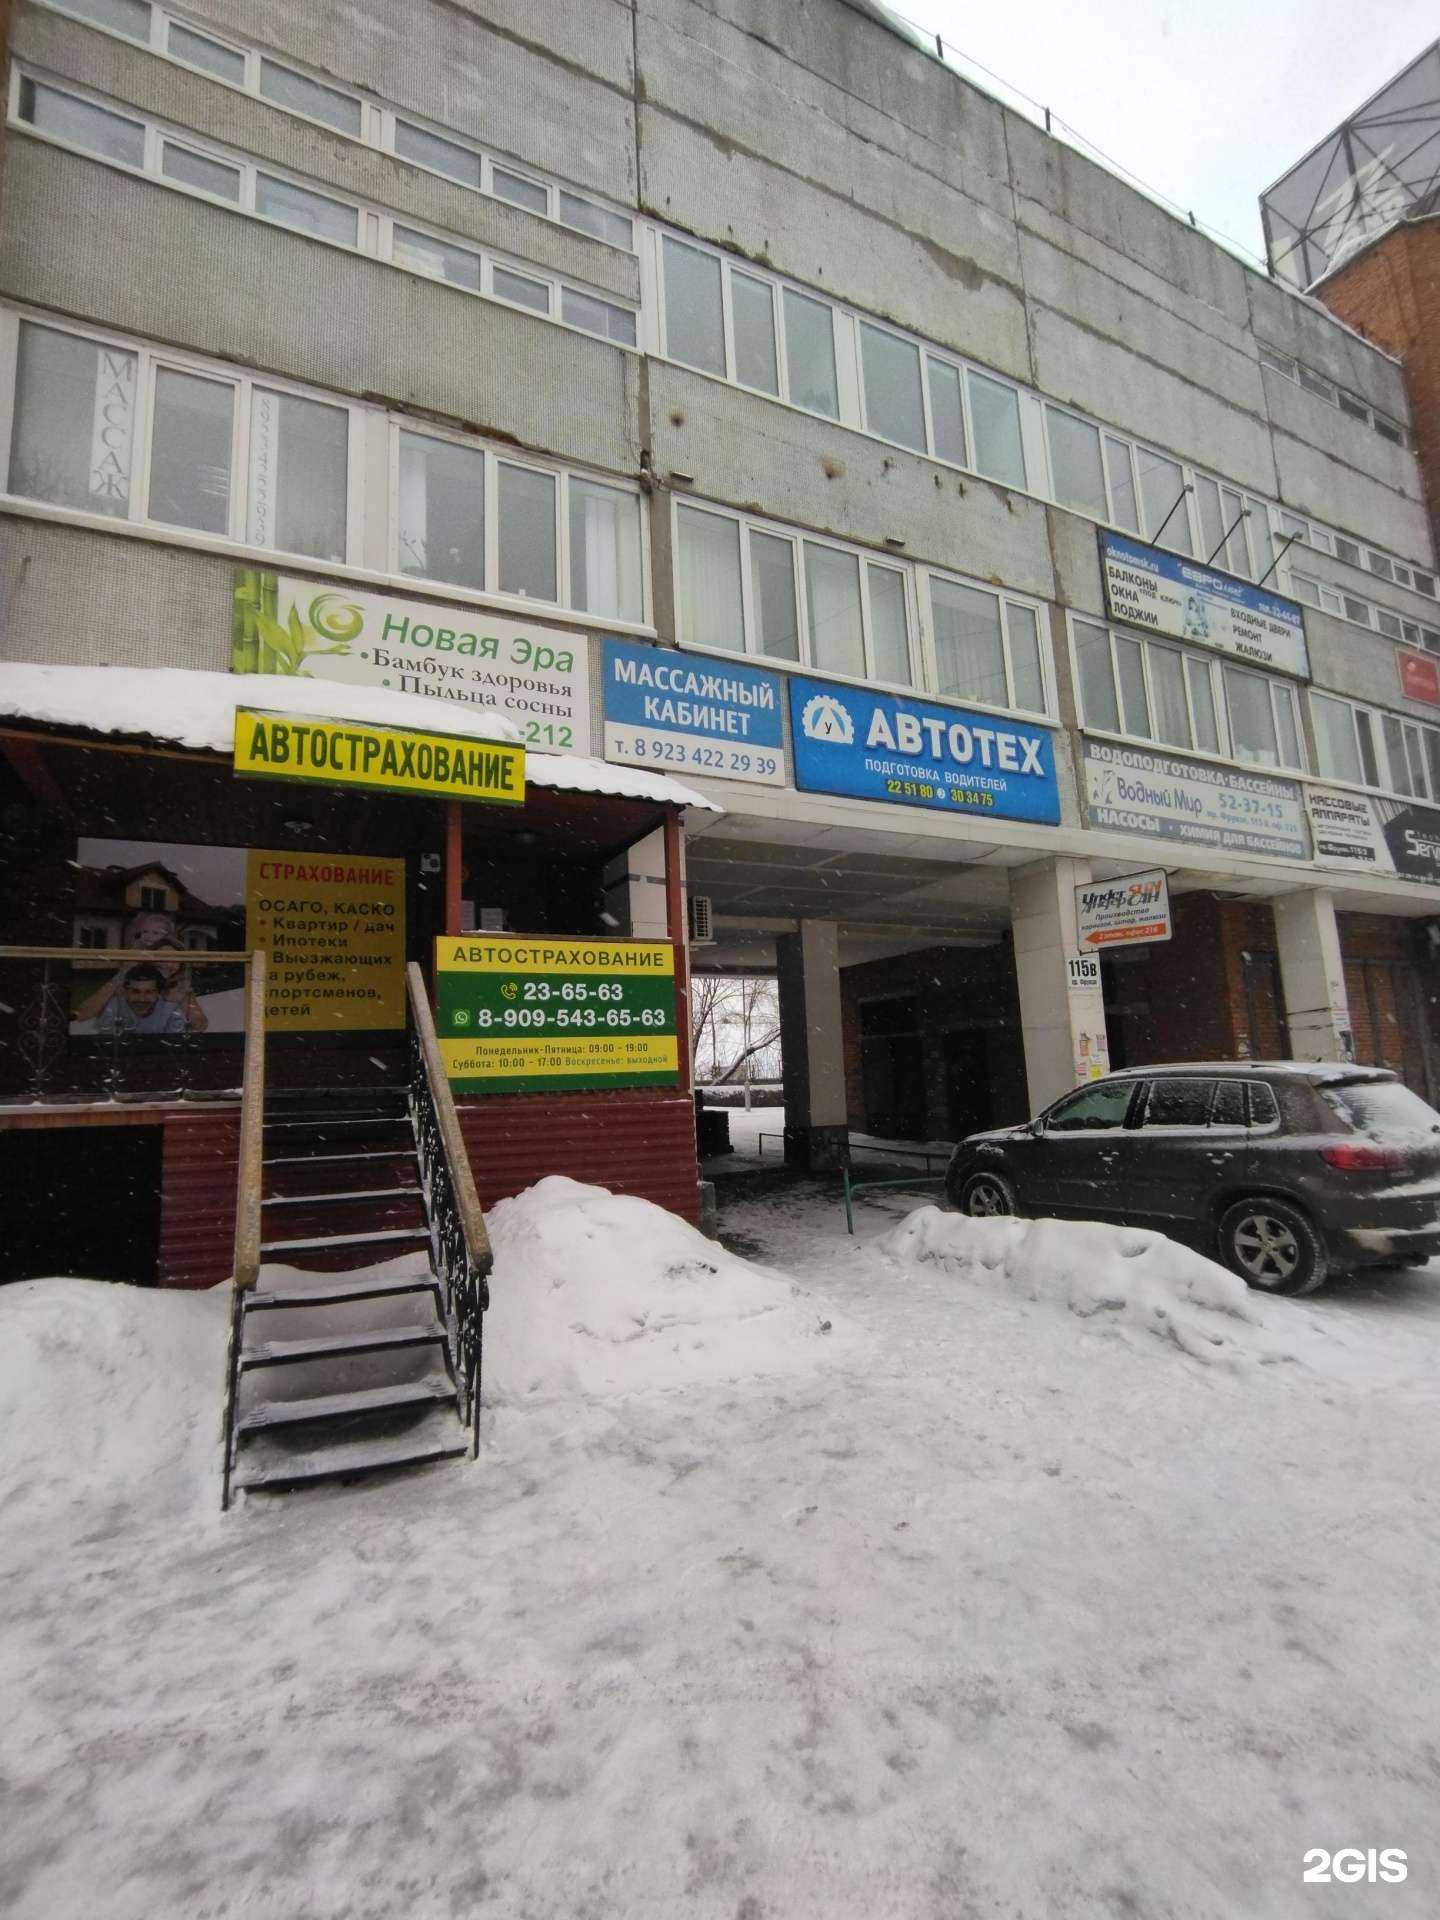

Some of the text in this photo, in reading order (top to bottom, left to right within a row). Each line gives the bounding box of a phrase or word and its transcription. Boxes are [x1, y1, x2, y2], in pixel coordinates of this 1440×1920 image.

[93, 353, 132, 500] МАССАЖ
[1108, 566, 1158, 592] БАЛКОНЫ
[1111, 584, 1139, 603] ОКНА
[1114, 602, 1158, 625] ЛОДЖИИ
[1231, 608, 1291, 639] ВХОДНЫЕ ДВЕРИ
[382, 613, 574, 673] Новая Эра
[1233, 625, 1262, 643] РЕМОНТ
[1236, 642, 1272, 662] ЖАЛЮЗИ
[372, 648, 572, 698] Бамбук здоровья
[614, 658, 774, 710] МАССАЖНЫЙ
[400, 674, 572, 719] Пыльца сосны
[644, 695, 750, 735] КАБИНЕТ
[865, 708, 1046, 777] АВТОТЕХ
[249, 722, 515, 790] АВТОСТРАХОВАНИЕ
[615, 738, 776, 775] т. 8 923 422 29 39
[865, 758, 1007, 792] ПОДГОТОВКА ВОДИТЕЛЕЙ
[888, 780, 993, 806] 22 51 80 30 34 75
[1117, 777, 1202, 818] Водный Мир
[1218, 793, 1283, 818] 52-37-15
[1312, 808, 1370, 826] АППАРАТЫ
[1097, 808, 1160, 832] НАСОСЫ
[1180, 824, 1220, 842] ХИМИЯ
[1223, 832, 1245, 845] ДЛЯ
[260, 862, 395, 886] СТРАХОВАНИЕ
[259, 900, 395, 916] ОСАГО, КАСКО
[273, 918, 348, 934] Квартир
[364, 923, 395, 934] дач
[273, 934, 347, 947] Ипотеки
[273, 952, 392, 966] Выезжающих
[453, 946, 664, 967] АВТОСТРАХОВАНИЕ
[265, 988, 381, 1000] портсменов,
[524, 983, 623, 1001] 23-65-63
[265, 1004, 312, 1018] етей
[478, 1008, 666, 1027] 8-909-543-65-63
[475, 1044, 585, 1056] Понедельник-Пятница:
[589, 1043, 614, 1053] 09:00
[625, 1043, 648, 1052] 19:00
[453, 1059, 495, 1070] Суббота:
[499, 1058, 525, 1068] 10:00
[537, 1057, 562, 1067] 17:00
[565, 1055, 624, 1066] Воскресенье:
[627, 1055, 668, 1065] выходной
